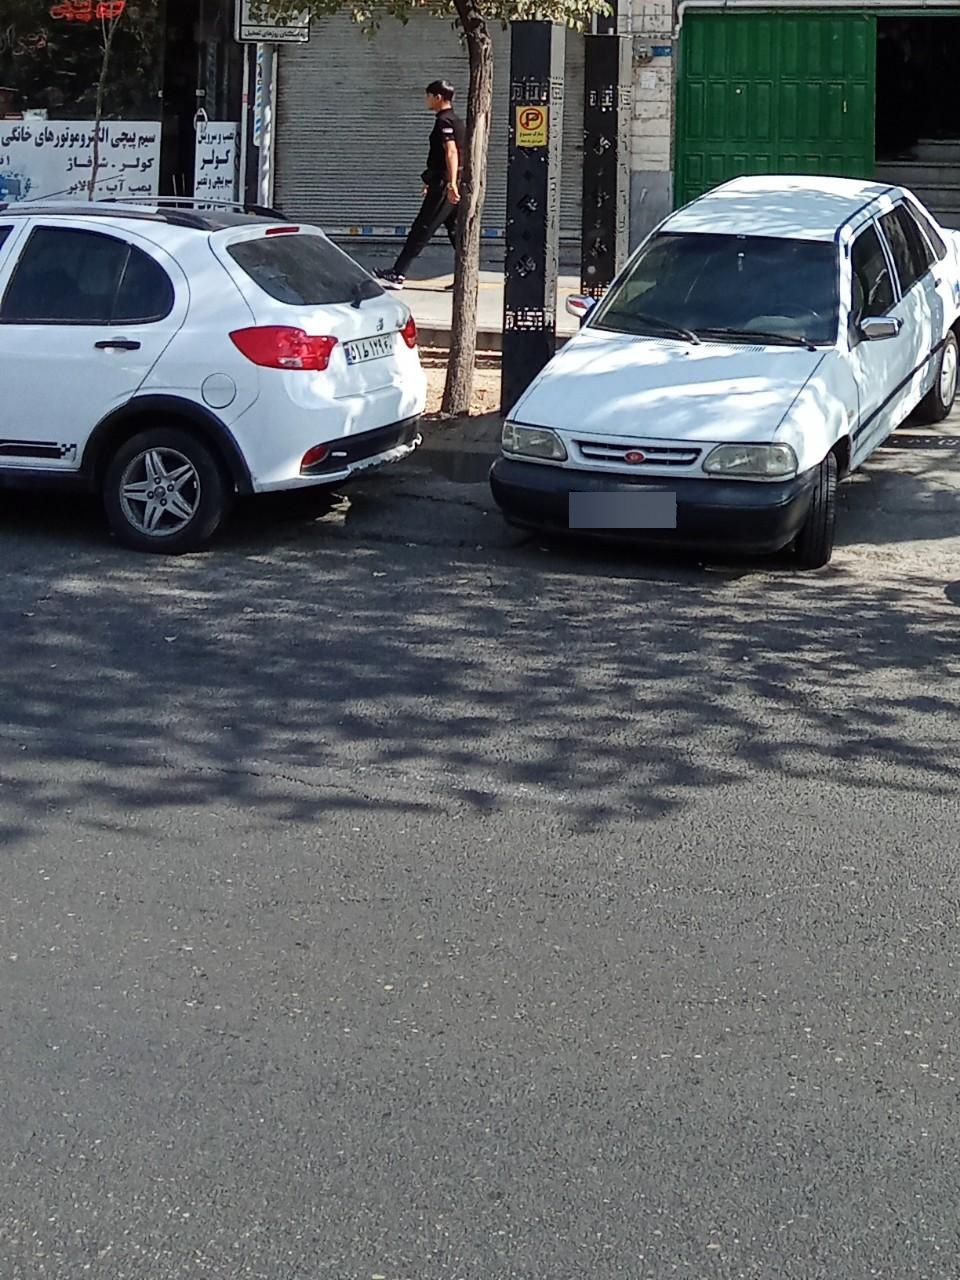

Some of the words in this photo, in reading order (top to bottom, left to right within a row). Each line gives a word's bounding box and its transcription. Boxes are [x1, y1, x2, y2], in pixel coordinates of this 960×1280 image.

[1, 125, 32, 147] خانگی
[111, 130, 136, 149] پیچی
[138, 133, 156, 148] سیم
[118, 157, 154, 171] کولر
[200, 149, 231, 170] کولر
[106, 179, 126, 195] آب
